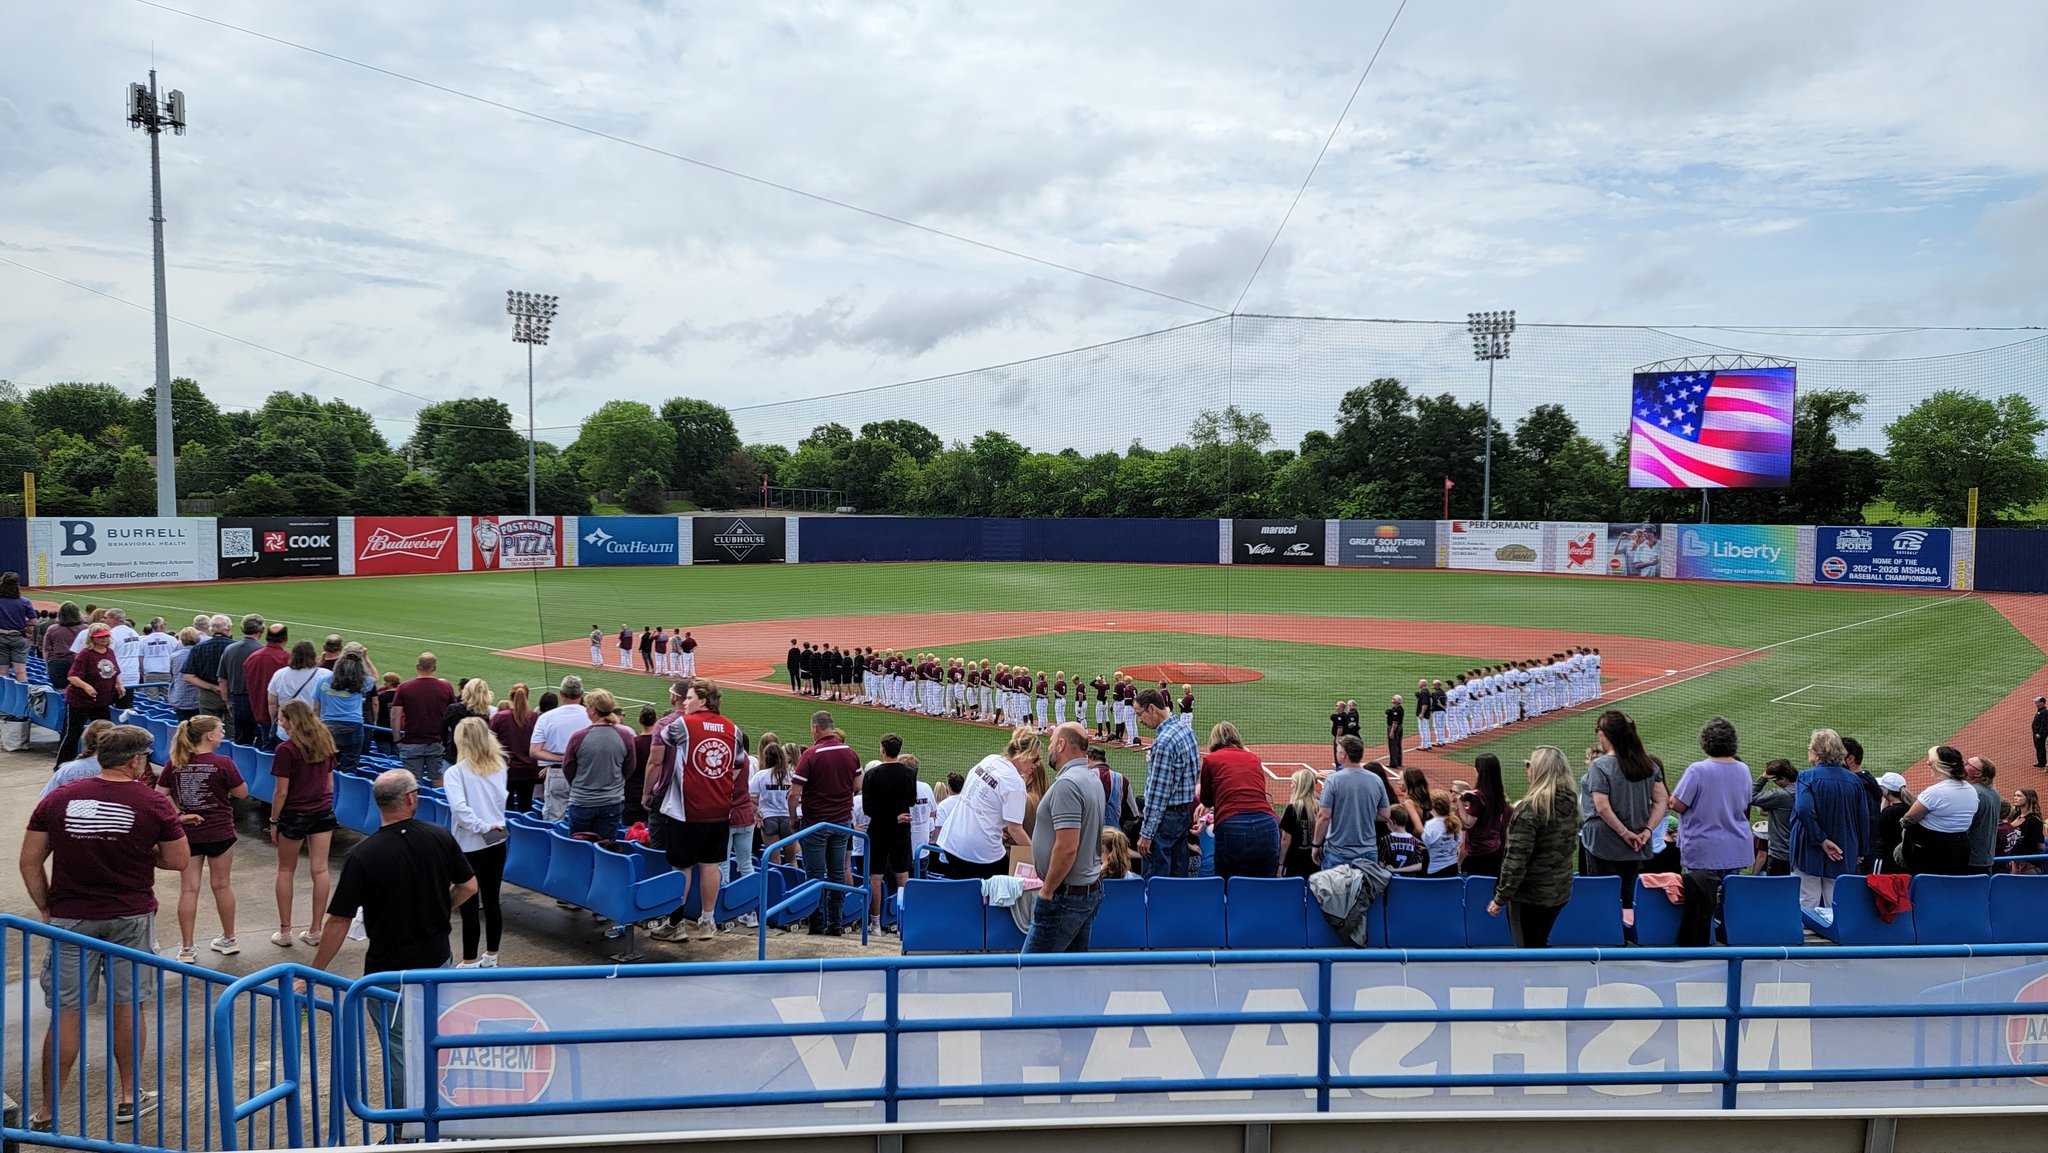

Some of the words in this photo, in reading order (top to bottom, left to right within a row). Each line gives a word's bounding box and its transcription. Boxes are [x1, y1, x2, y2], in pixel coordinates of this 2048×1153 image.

[1261, 525, 1298, 534] marucci
[1470, 521, 1540, 530] PERFORMANCE
[108, 529, 185, 538] BURRELL
[289, 536, 331, 548] COOK
[368, 535, 445, 551] Budweiser
[714, 536, 766, 544] CLUBHOUSE
[501, 536, 556, 556] PIZZA
[1243, 543, 1276, 555] Victus
[1570, 547, 1593, 555] Coca-Cola
[1714, 542, 1781, 563] Liberty
[74, 571, 179, 580] www.BurrellCenter.com
[1901, 567, 1938, 575] MSHSAA
[1885, 574, 1942, 583] CHAMPIONSHIPS
[703, 722, 725, 733] WHITE
[698, 742, 729, 755] WILDCAT
[704, 767, 722, 776] TRAP
[1396, 854, 1408, 868] 7
